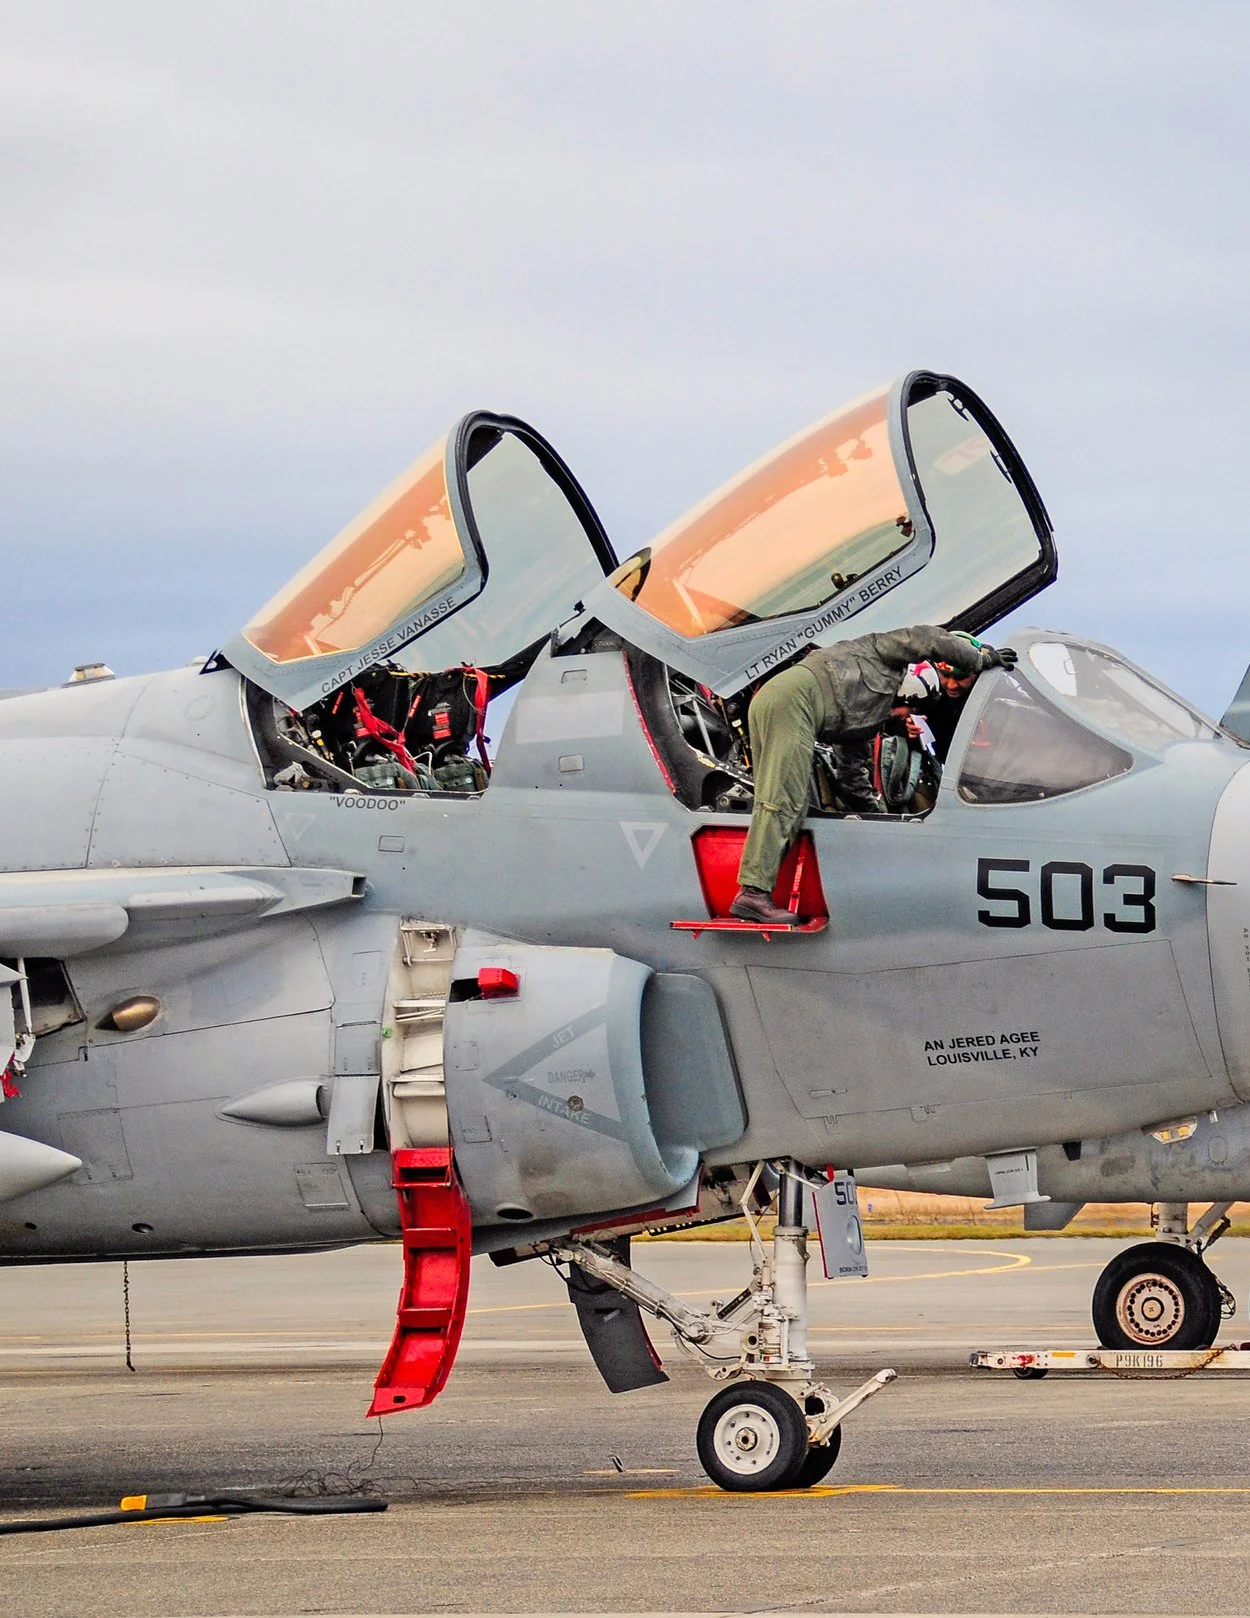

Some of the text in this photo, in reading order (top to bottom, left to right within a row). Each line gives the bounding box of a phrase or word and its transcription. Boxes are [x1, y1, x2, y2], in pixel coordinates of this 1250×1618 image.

[744, 566, 903, 680] LT RYAN "GUMMY" BERRY
[321, 596, 457, 694] CAPT JESSE VANASSE
[329, 796, 406, 811] "VOODOO"
[977, 857, 1156, 934] 503
[552, 1027, 576, 1050] JET
[924, 1031, 1041, 1052] AN JERED AGEE
[927, 1046, 1039, 1066] LOUISVILLE, KY
[546, 1069, 588, 1084] DANGER
[1116, 1354, 1163, 1368] P9K196
